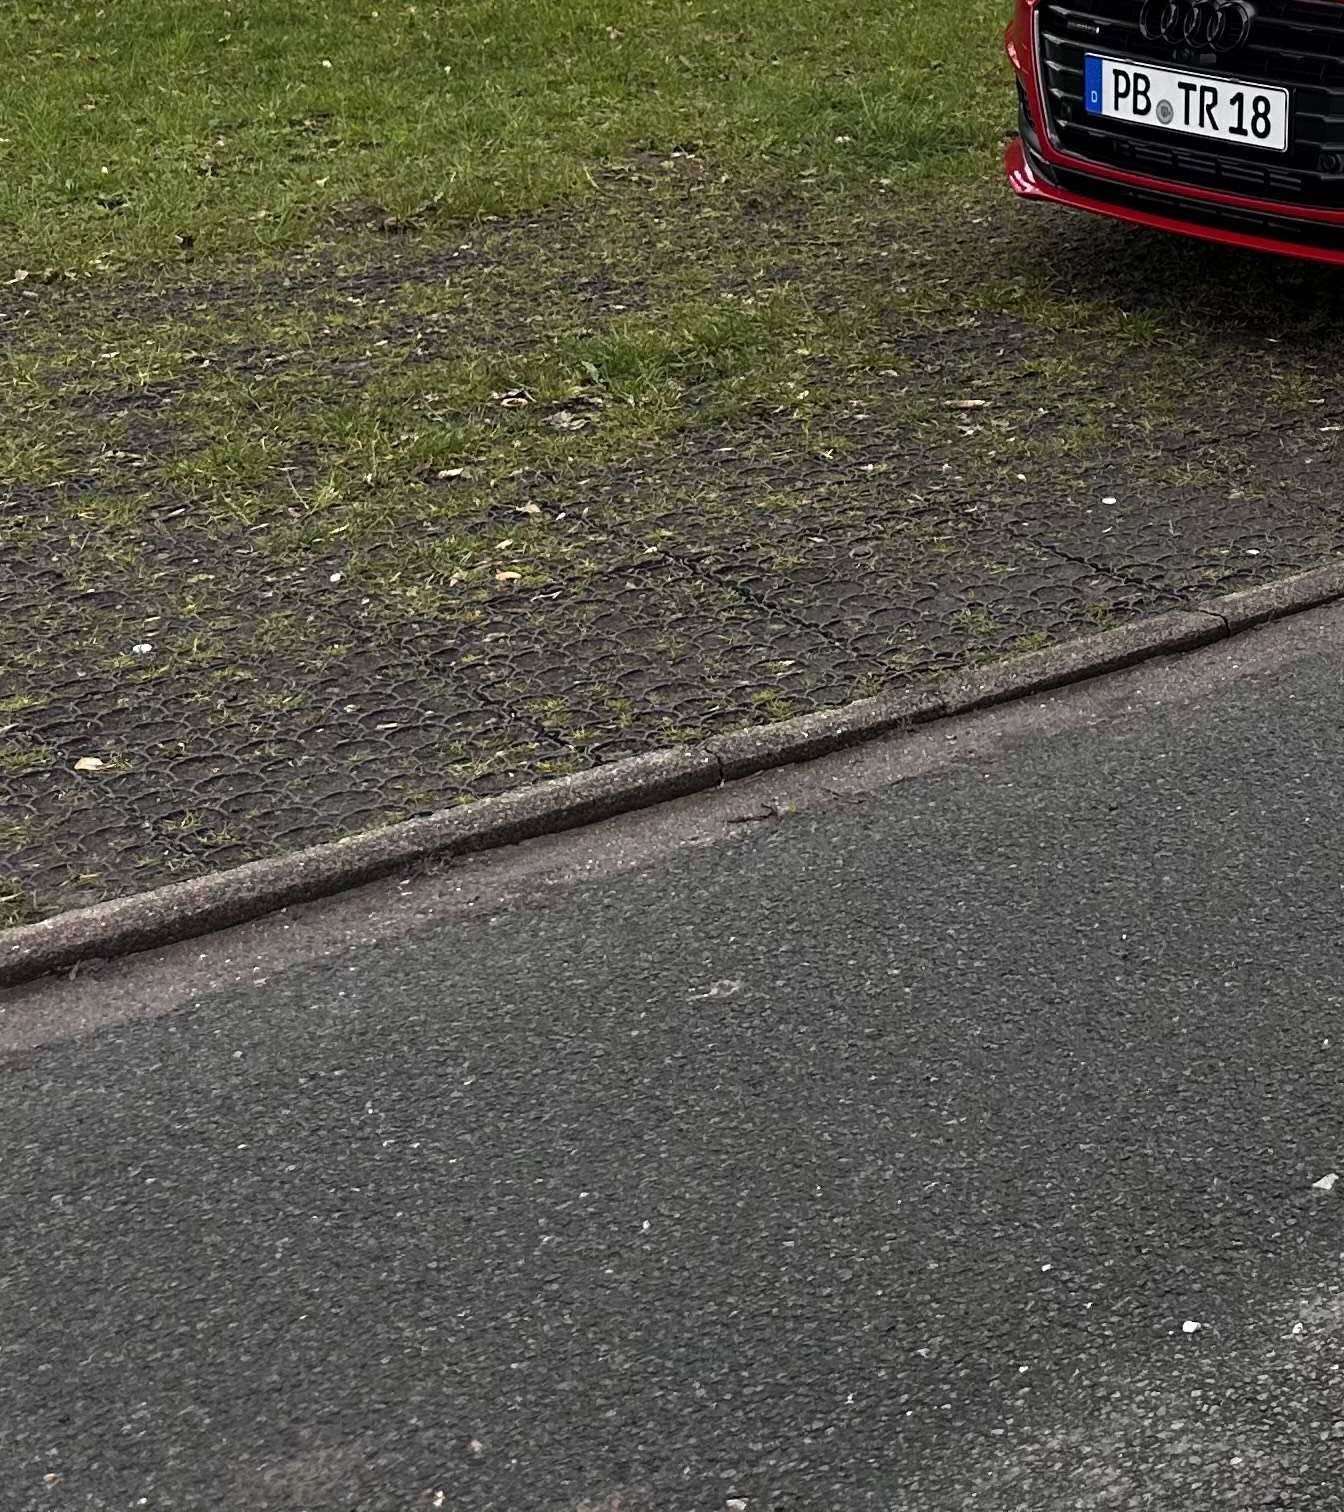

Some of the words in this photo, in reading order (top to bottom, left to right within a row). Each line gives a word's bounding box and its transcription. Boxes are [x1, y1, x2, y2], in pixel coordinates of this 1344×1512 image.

[1112, 68, 1152, 116] PB
[1177, 81, 1219, 131] TR
[1228, 91, 1271, 139] 18
